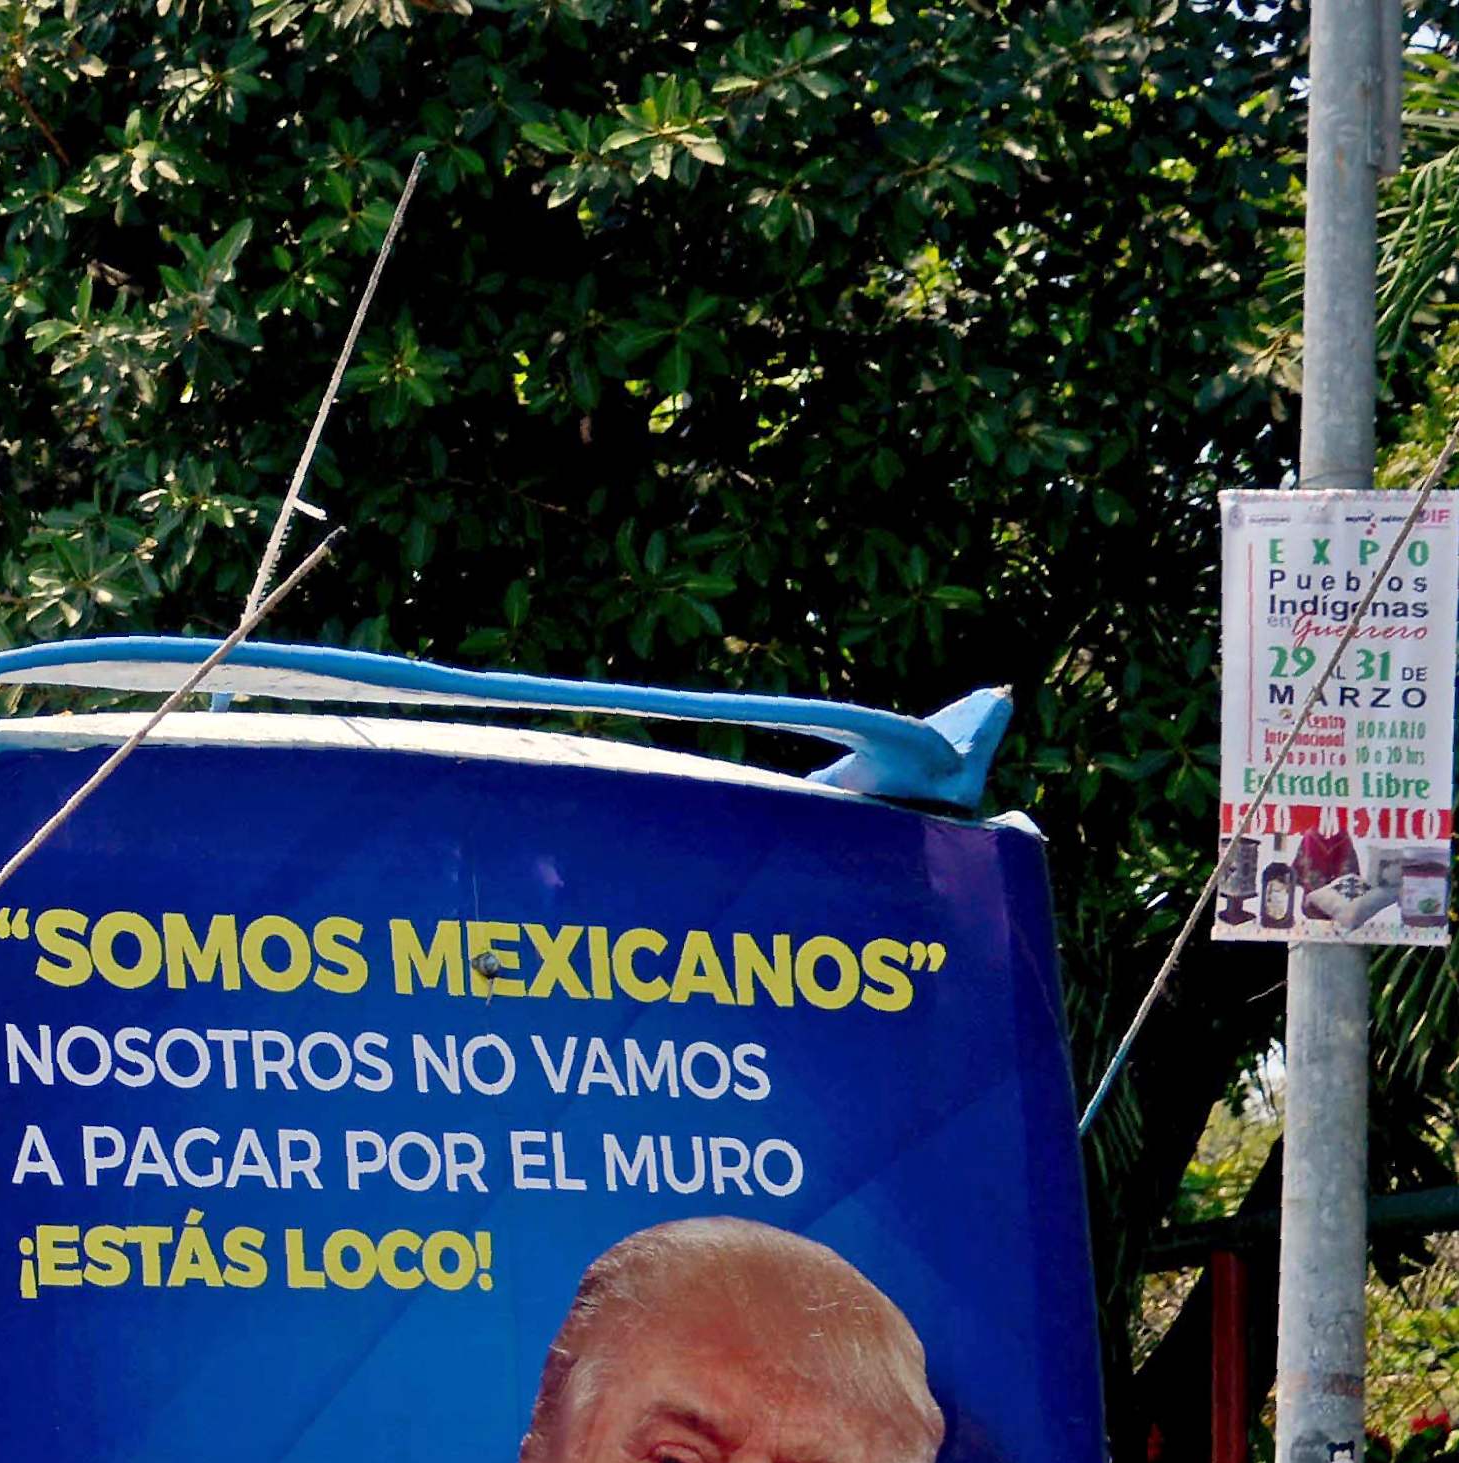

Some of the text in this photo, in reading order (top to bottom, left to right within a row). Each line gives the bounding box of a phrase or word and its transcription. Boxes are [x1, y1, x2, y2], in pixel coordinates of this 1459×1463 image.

[1269, 538, 1430, 567] EXPO
[1267, 616, 1291, 628] en
[1268, 646, 1317, 678] 29
[1356, 648, 1392, 682] 31
[1402, 666, 1428, 682] DE
[1356, 720, 1427, 739] HORARIO
[1265, 747, 1347, 766] Aapulco
[1362, 771, 1432, 800] Libre
[389, 918, 947, 1013] MEXICANOS”
[5, 1022, 772, 1101] NOSOTROS NO VAMOS
[11, 1124, 804, 1197] A PAGAR POR EL MURO
[18, 1207, 495, 1300] ¡ESTÁS LOCO!
